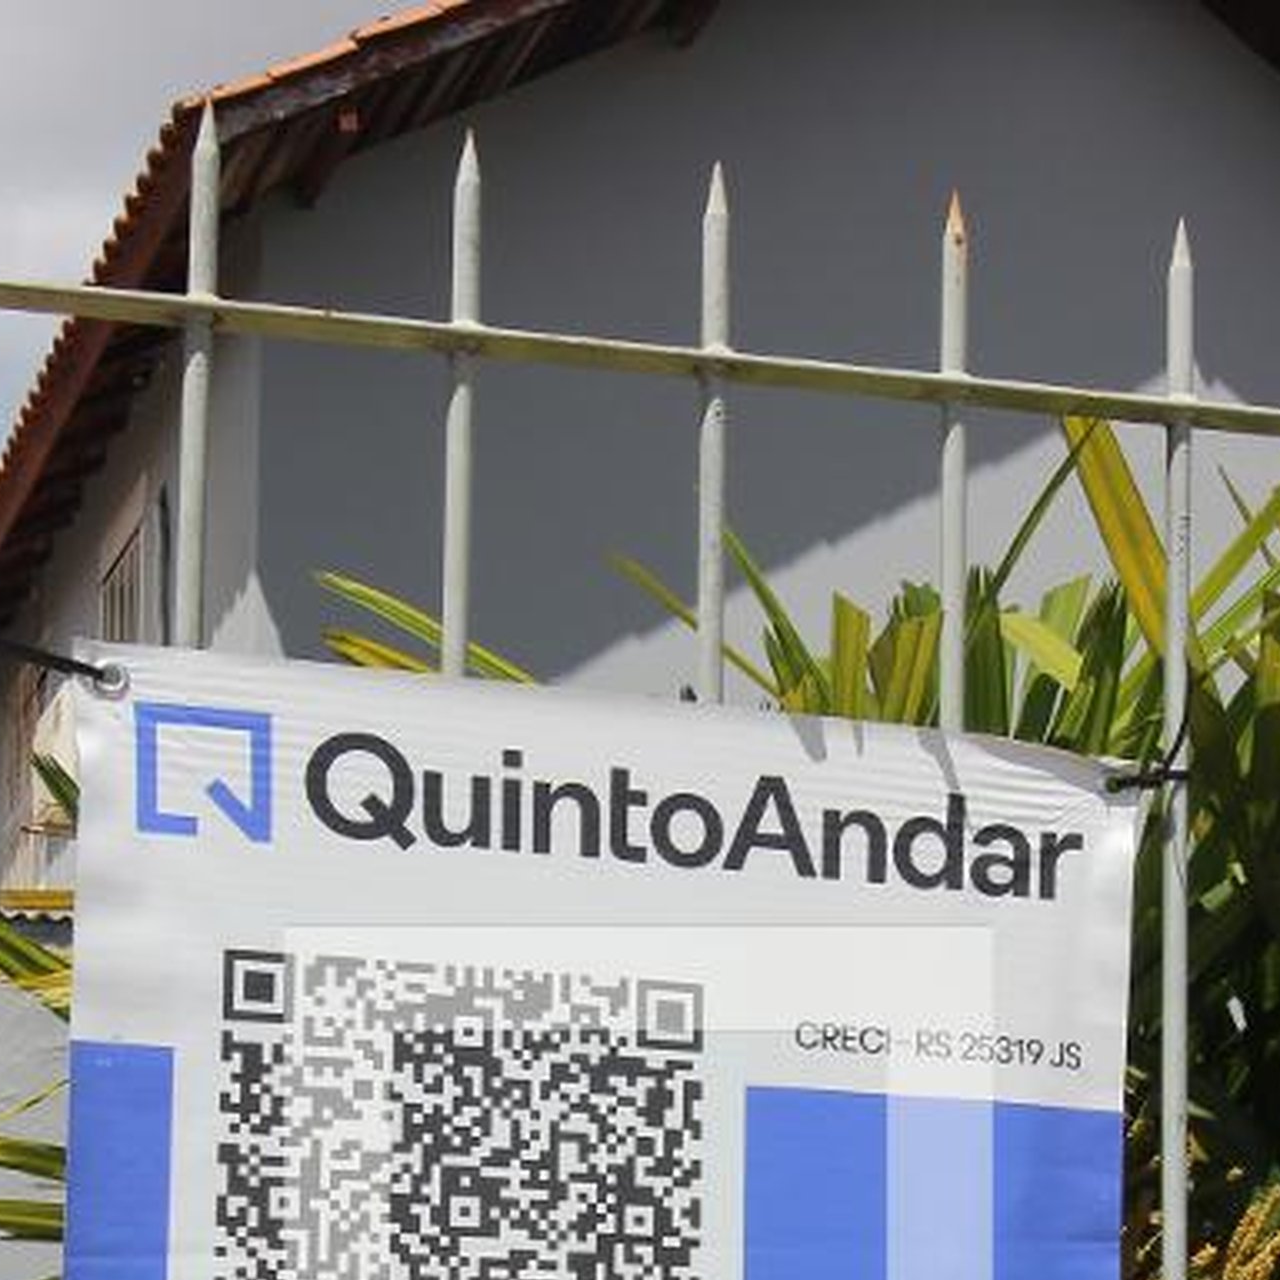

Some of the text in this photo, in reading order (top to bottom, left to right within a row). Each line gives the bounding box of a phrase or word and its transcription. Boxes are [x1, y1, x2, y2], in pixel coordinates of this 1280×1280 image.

[304, 731, 1083, 903] QuintoAndar
[795, 1022, 891, 1055] CRECI
[915, 1029, 952, 1058] RS
[960, 1032, 1044, 1065] 25319
[1050, 1041, 1082, 1070] JS
